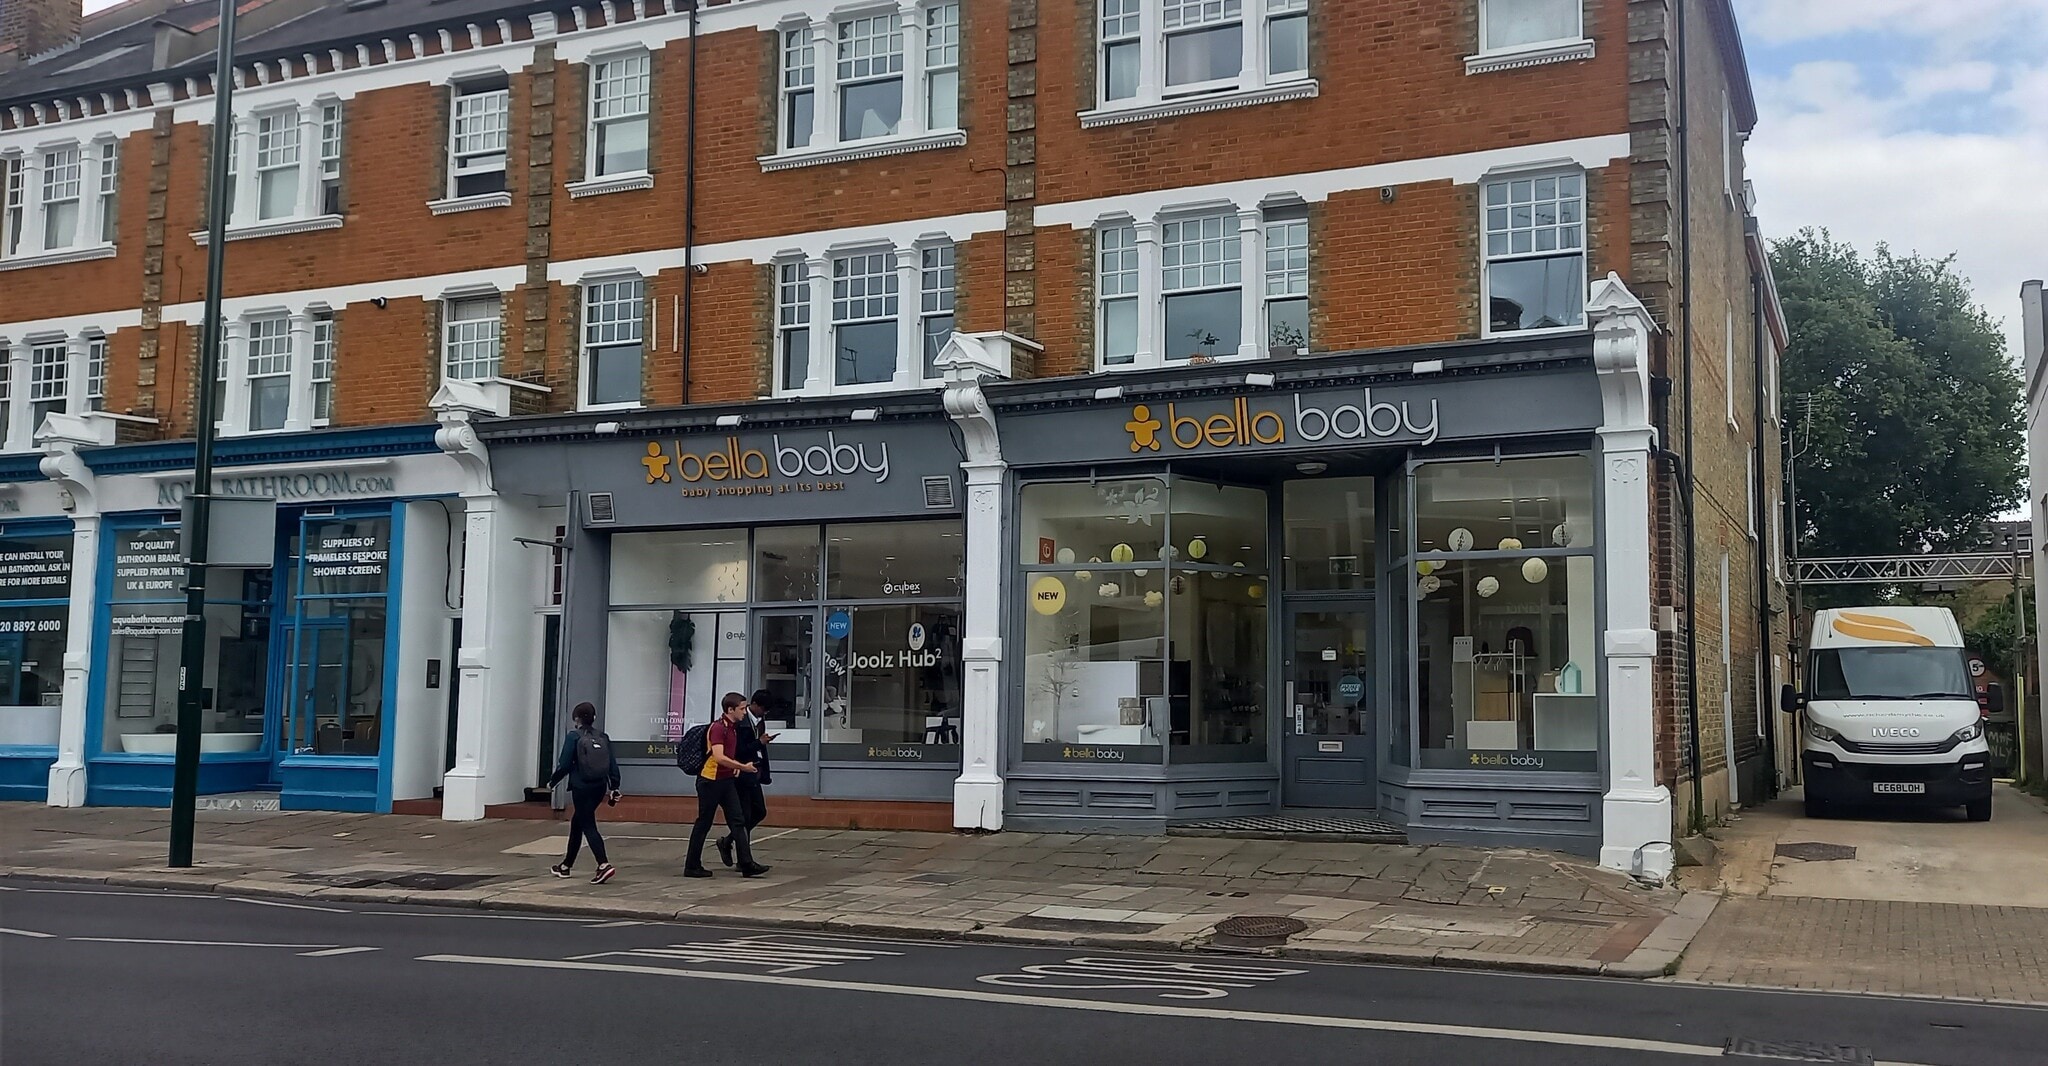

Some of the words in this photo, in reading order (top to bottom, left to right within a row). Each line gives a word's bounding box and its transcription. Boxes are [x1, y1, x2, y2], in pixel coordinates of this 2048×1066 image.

[1168, 396, 1285, 449] bella
[1293, 386, 1439, 447] baby
[675, 436, 769, 482] bella
[773, 430, 890, 483] baby
[681, 486, 711, 498] baby
[715, 483, 773, 497] shopping
[778, 483, 790, 493] at
[795, 482, 812, 492] its
[817, 479, 845, 491] best
[130, 542, 144, 550] TOP
[144, 540, 175, 550] QUALITY
[322, 538, 363, 548] SUPPLIERS
[363, 537, 376, 547] OF
[4, 552, 19, 561] CAN
[19, 551, 45, 560] INSTALL
[45, 550, 65, 560] YOUR
[117, 555, 157, 564] BATHROOM
[308, 552, 351, 563] FRAMELESS
[352, 550, 388, 561] BESPOKE
[47, 562, 62, 572] ASK
[62, 562, 71, 571] IN
[117, 568, 149, 577] SUPPLIED
[149, 567, 170, 576] FROM
[170, 567, 185, 576] THE
[312, 566, 347, 577] SHOWER
[347, 565, 382, 575] SCREENS
[7, 577, 21, 586] FOR
[21, 576, 41, 586] MORE
[41, 575, 67, 585] DETAILS
[126, 581, 138, 590] UK
[138, 581, 144, 589] &
[145, 580, 173, 589] EUROPE
[893, 581, 921, 595] cybex
[1037, 591, 1059, 601] NEW
[12, 621, 36, 632] 8892
[37, 620, 61, 631] 6000
[830, 621, 847, 631] NEW
[734, 631, 746, 641] cyb
[848, 651, 894, 669] Joolz
[1972, 663, 1979, 672] 5
[1871, 727, 1921, 737] IVECO
[654, 745, 674, 754] bella
[875, 747, 897, 757] bella
[897, 747, 922, 760] baby
[1072, 747, 1096, 759] bella
[1096, 748, 1125, 761] baby
[1481, 753, 1509, 765] bella
[1510, 754, 1544, 769] baby
[1877, 783, 1920, 792] CE68LOH
[975, 956, 1310, 1000] BUS
